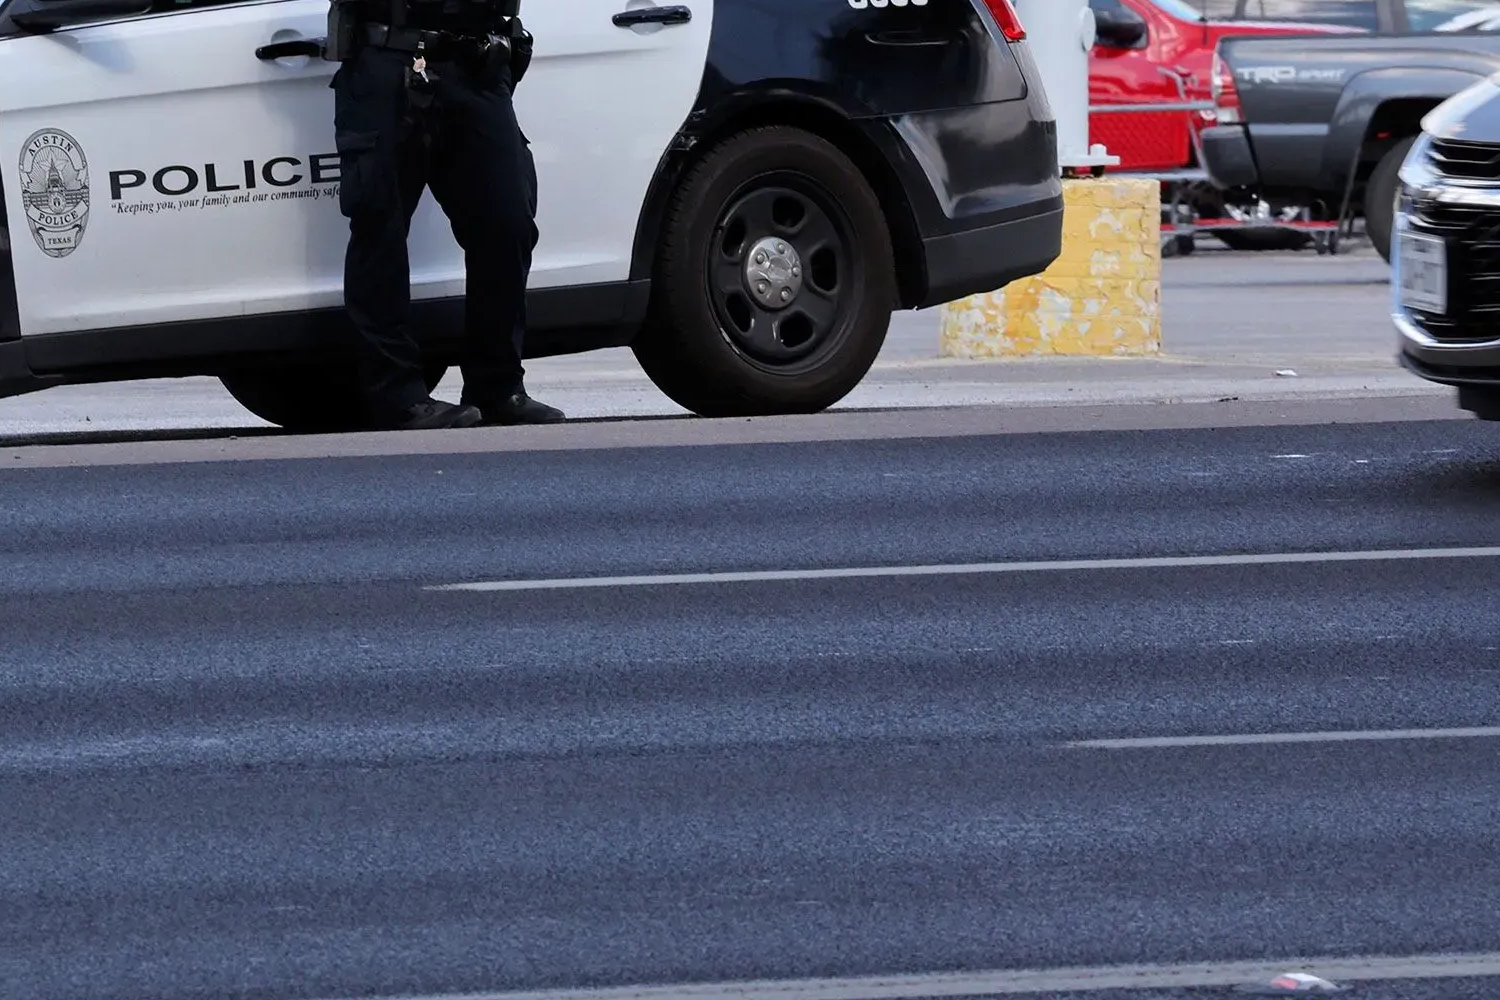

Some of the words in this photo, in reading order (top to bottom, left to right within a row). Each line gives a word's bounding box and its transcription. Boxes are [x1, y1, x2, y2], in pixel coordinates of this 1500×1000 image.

[1236, 66, 1296, 84] TRD
[28, 134, 74, 157] AUSTIN
[109, 152, 341, 201] POLICE
[156, 201, 176, 214] you,
[178, 199, 200, 212] your
[200, 194, 232, 209] family
[232, 191, 251, 204] and
[252, 192, 269, 203] our
[270, 186, 321, 201] community
[38, 210, 79, 226] POLICE
[48, 236, 72, 245] TEXAS
